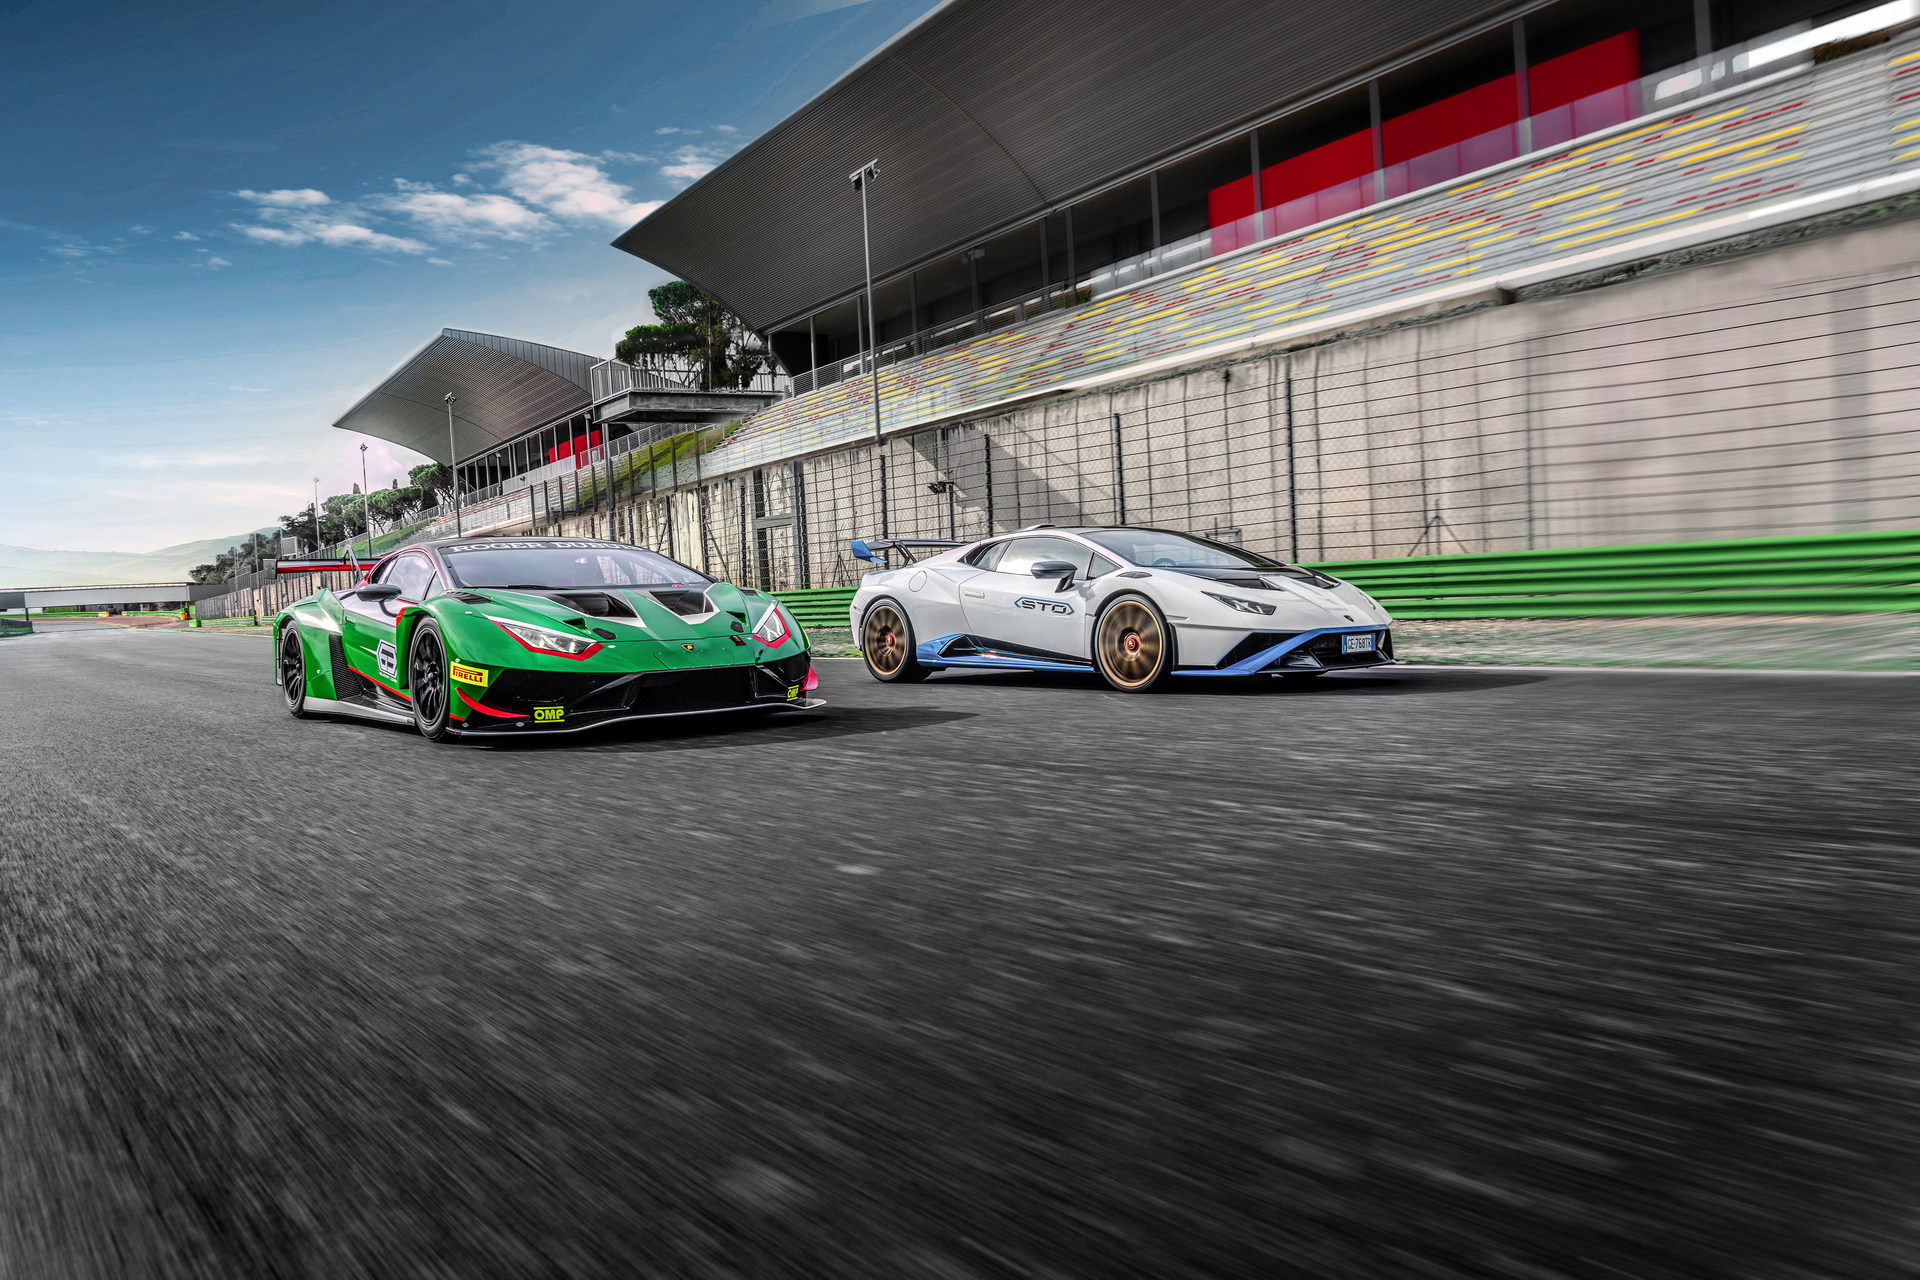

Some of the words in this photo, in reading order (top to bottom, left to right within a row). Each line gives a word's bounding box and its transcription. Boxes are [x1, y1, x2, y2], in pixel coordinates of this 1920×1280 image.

[452, 542, 546, 552] ROGER
[1021, 599, 1067, 614] STO
[452, 665, 484, 683] PIRELLI
[533, 708, 565, 720] OMP
